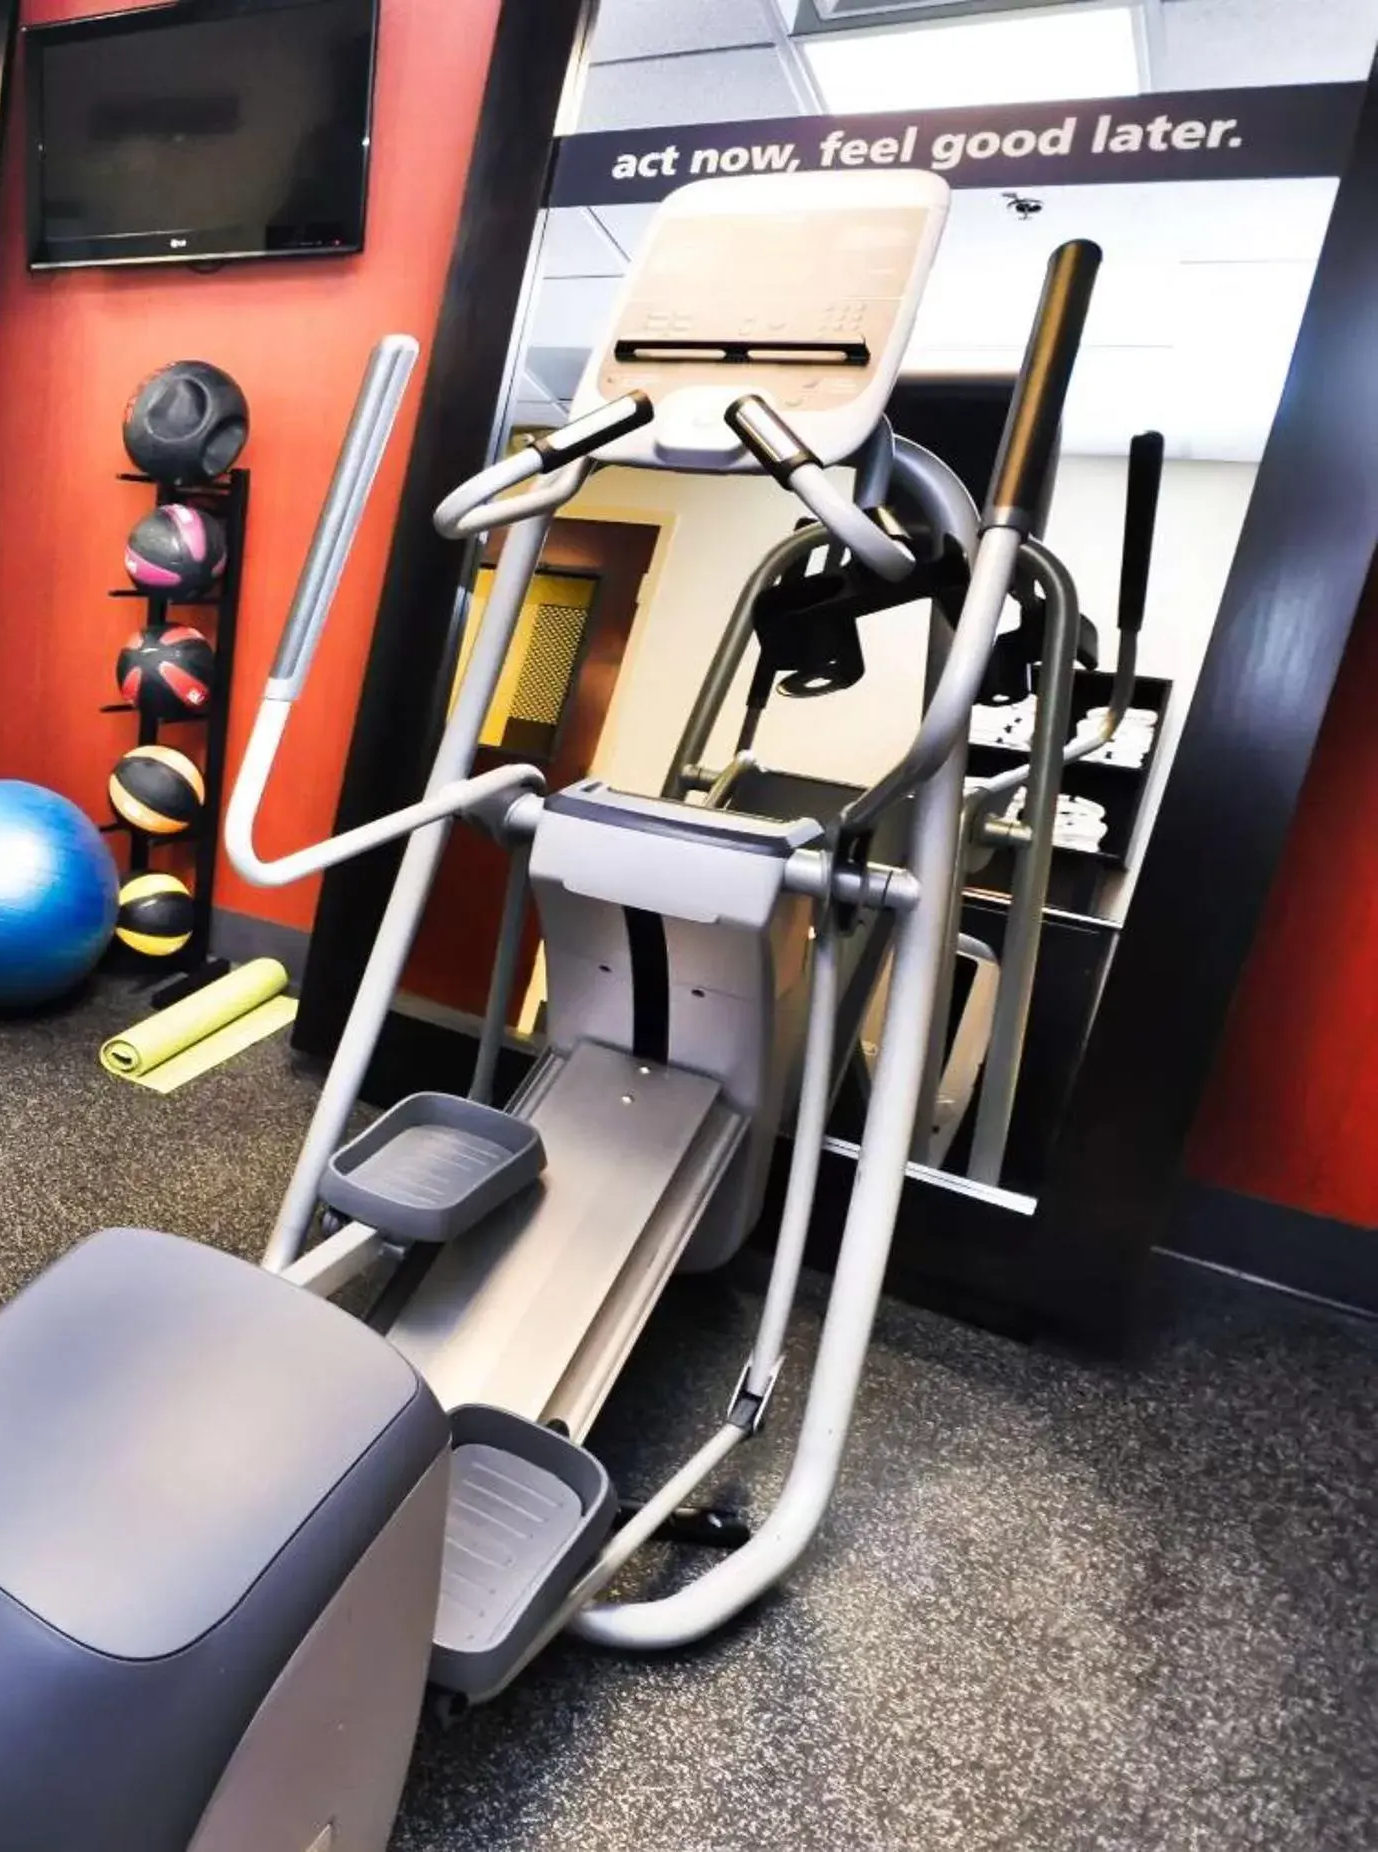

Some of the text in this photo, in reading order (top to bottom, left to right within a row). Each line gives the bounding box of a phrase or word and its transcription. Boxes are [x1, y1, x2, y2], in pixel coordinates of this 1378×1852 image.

[611, 113, 1243, 180] act now, feel good later.
